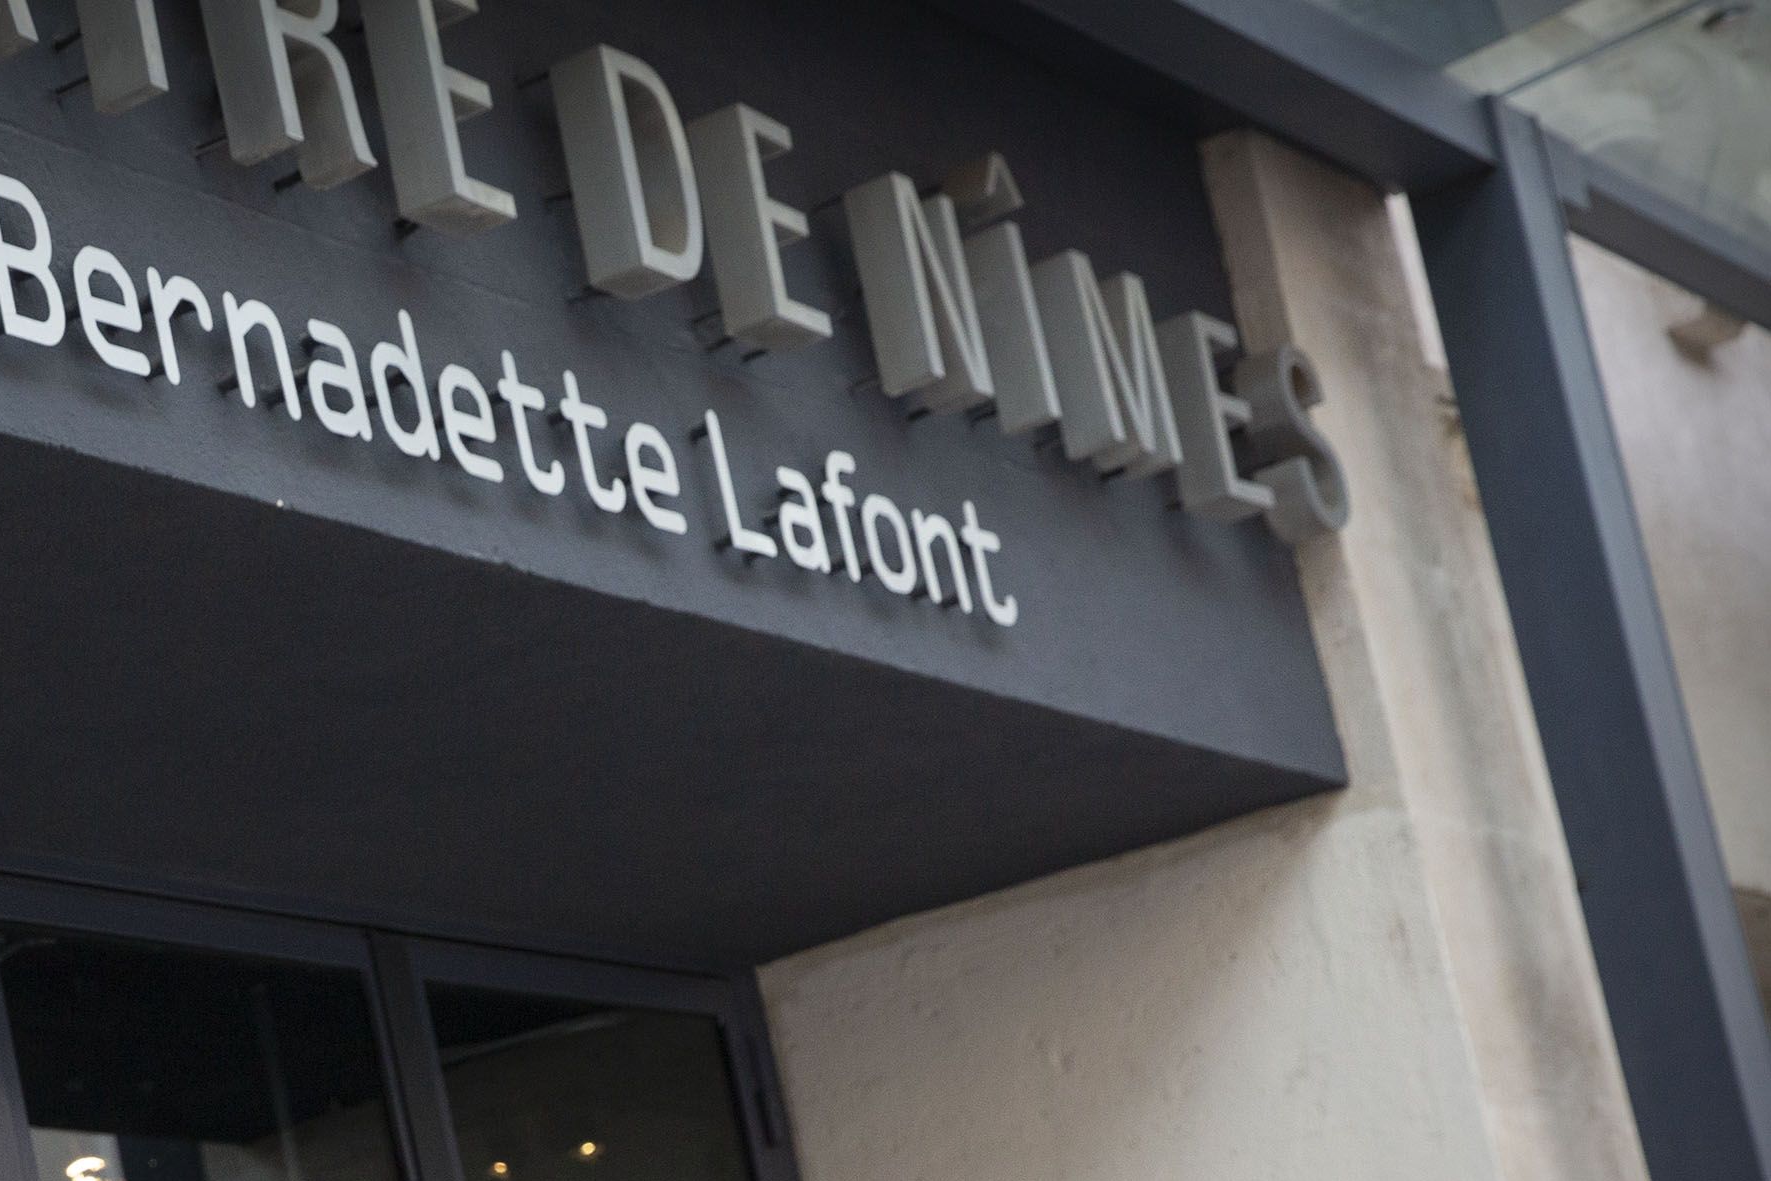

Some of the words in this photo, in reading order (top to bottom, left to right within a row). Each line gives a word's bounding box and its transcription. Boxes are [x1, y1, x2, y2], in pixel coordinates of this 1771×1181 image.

[550, 44, 833, 346] DE
[844, 150, 1351, 547] NÎMES
[704, 409, 1019, 627] Lafont
